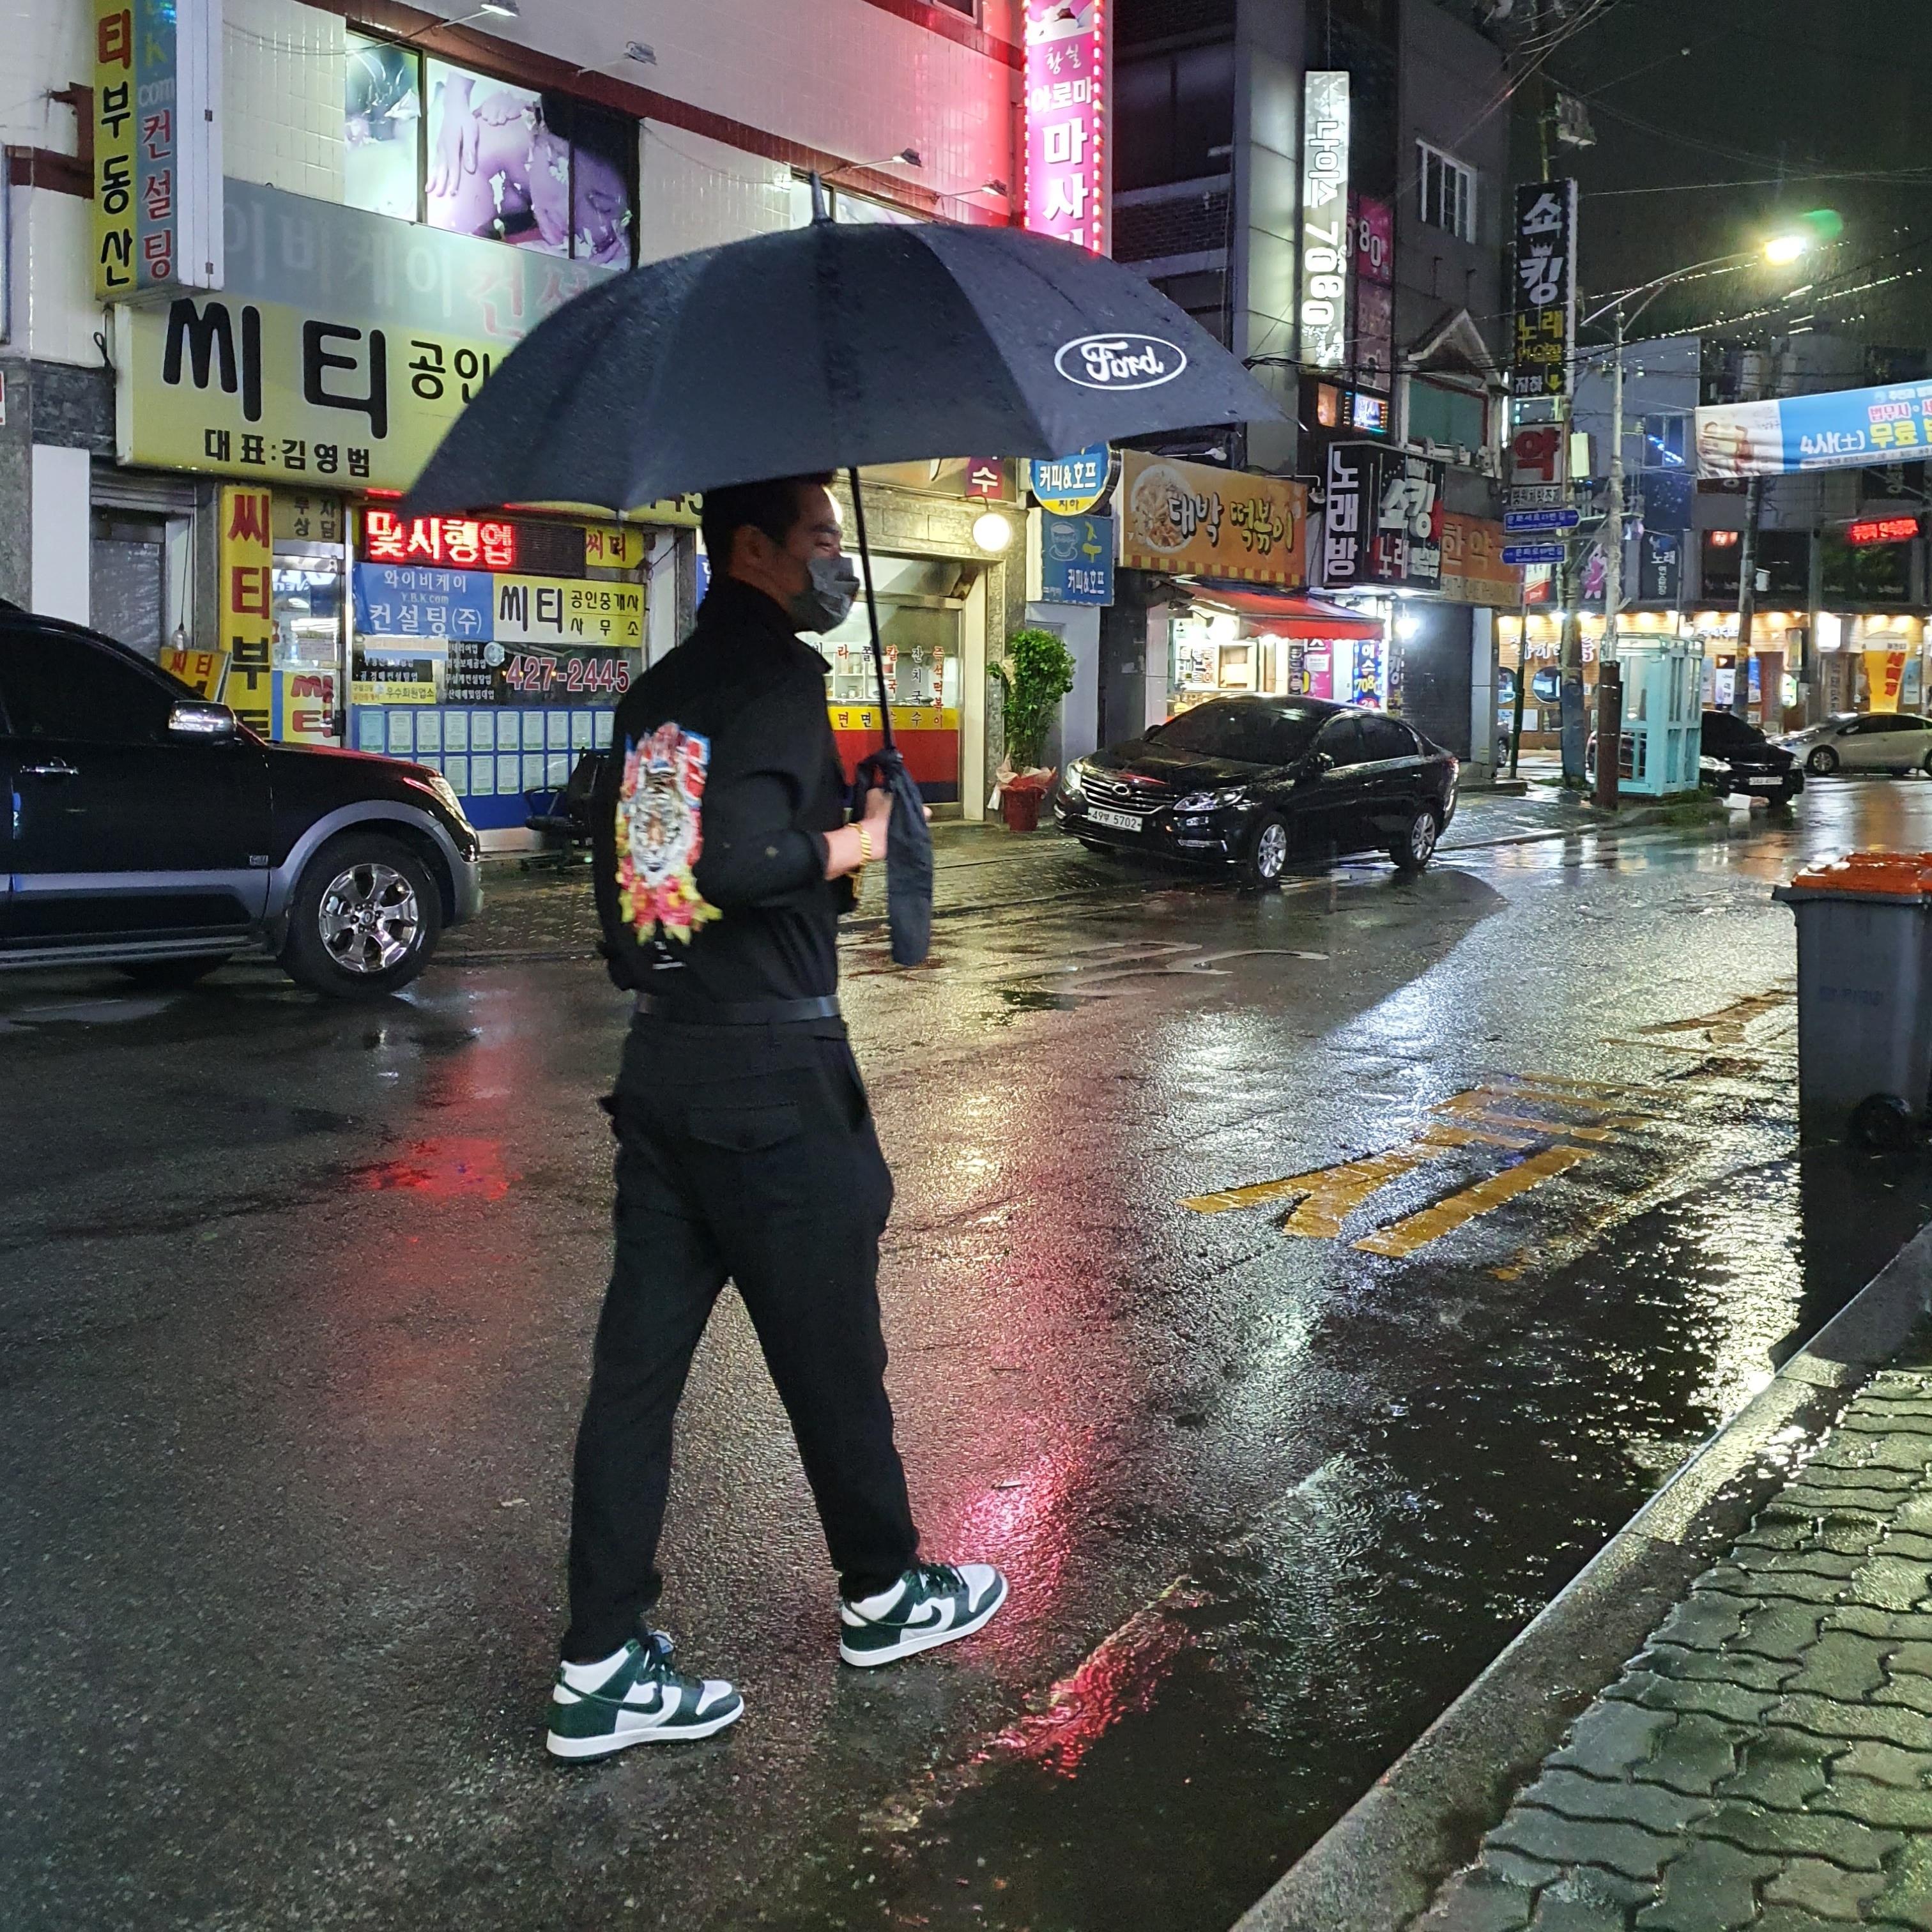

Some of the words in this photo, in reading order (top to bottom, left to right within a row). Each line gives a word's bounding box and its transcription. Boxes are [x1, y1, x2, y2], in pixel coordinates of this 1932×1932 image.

[1032, 76, 1093, 113] 아로마
[142, 109, 172, 280] 컨설팅
[162, 298, 388, 440] 씨티
[1081, 341, 1164, 382] Ford
[1514, 426, 1561, 481] 약
[1871, 421, 1919, 448] 무료
[1039, 461, 1096, 491] 커피&호프
[1167, 492, 1224, 548] 대박
[1230, 493, 1295, 554] 떡볶이
[1328, 450, 1359, 575] 노래방
[385, 569, 467, 594] 와이비케이
[1068, 569, 1105, 595] 커피&호프
[500, 585, 564, 633] 씨티
[571, 588, 640, 613] 공인중개사
[506, 656, 631, 693] 427-2445
[1113, 814, 1137, 829] 5702
